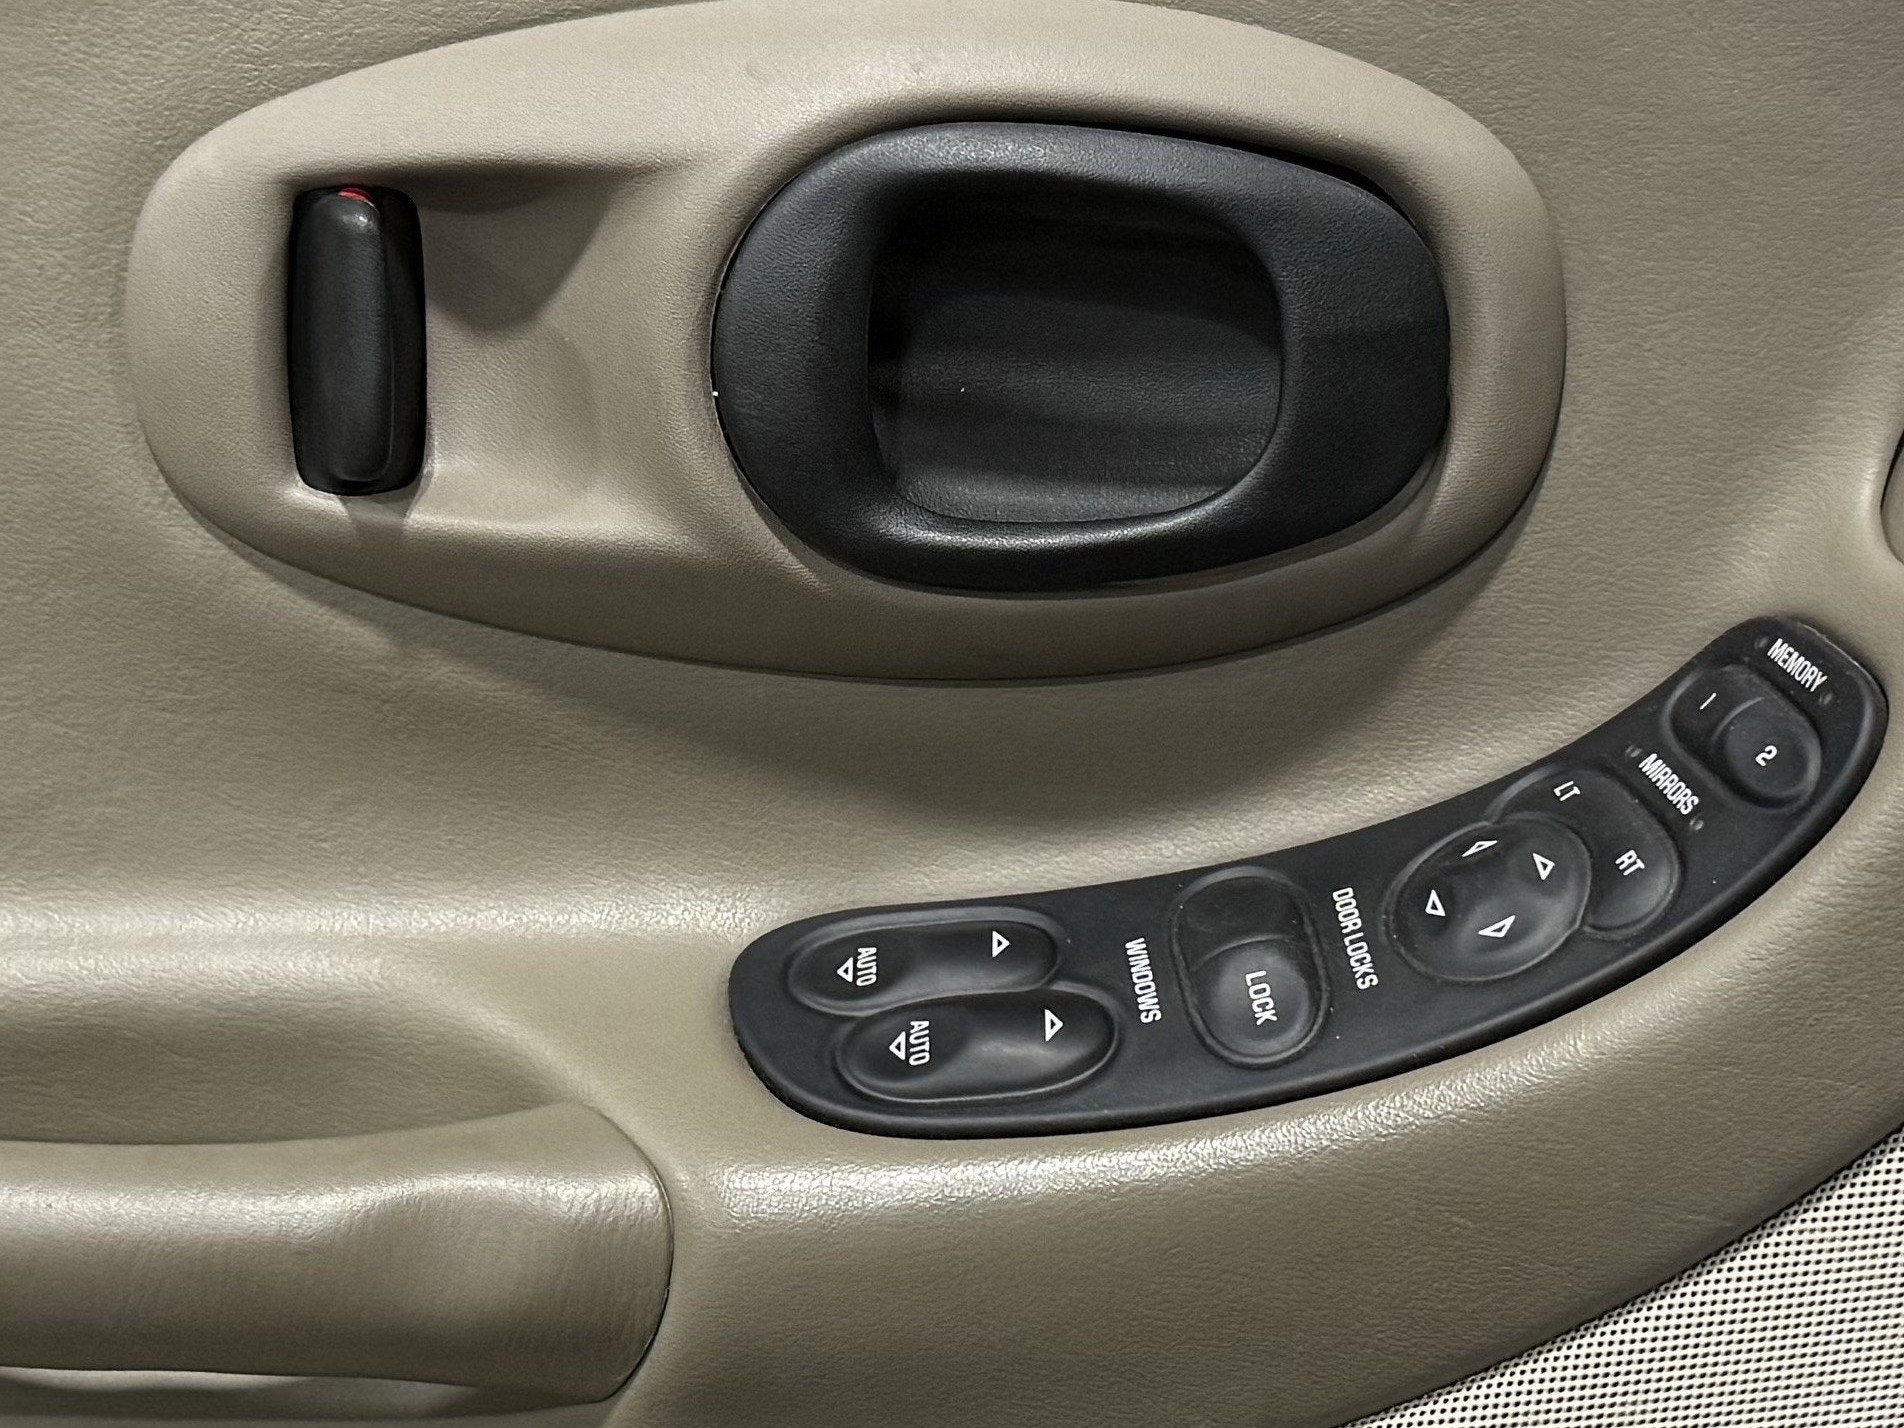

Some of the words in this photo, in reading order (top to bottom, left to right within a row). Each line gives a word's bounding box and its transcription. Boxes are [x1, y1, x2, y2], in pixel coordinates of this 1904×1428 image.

[1767, 638, 1828, 692] MEMORY
[1755, 745, 1778, 767] 2
[1553, 780, 1581, 802] LT
[1638, 753, 1700, 815] MIRRORS
[1615, 849, 1646, 876] RT
[1332, 887, 1365, 934] DOOR
[856, 947, 877, 987] AUTO
[1125, 937, 1162, 1024] WINDOWS
[1343, 932, 1379, 990] LOCKS
[1245, 970, 1278, 1026] LOCK
[908, 1020, 931, 1066] AUTO
